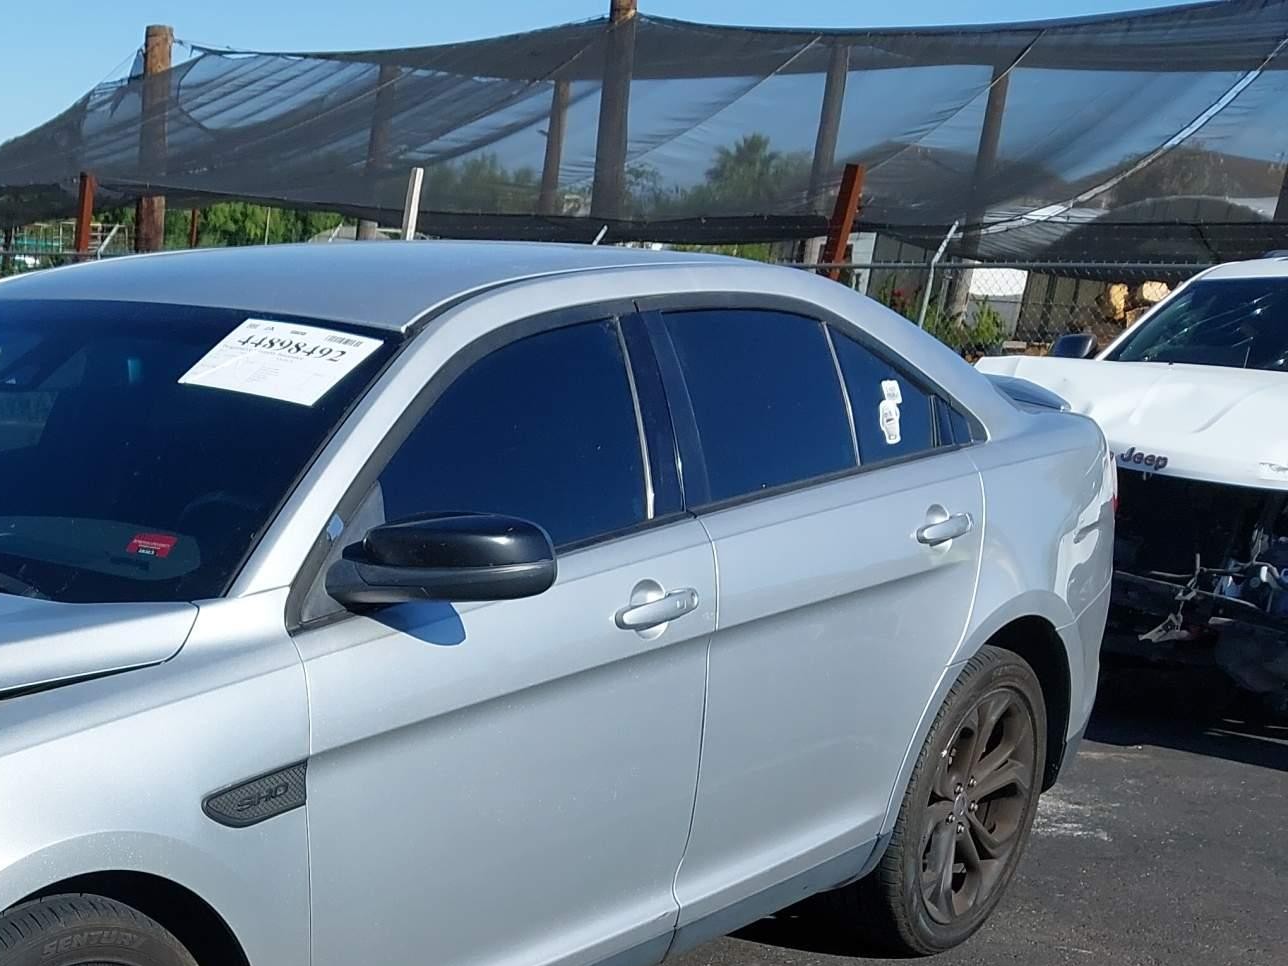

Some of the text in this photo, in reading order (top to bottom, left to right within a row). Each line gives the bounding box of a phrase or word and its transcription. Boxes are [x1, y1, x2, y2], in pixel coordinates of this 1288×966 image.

[237, 335, 347, 362] 44898492
[1120, 446, 1168, 471] Jeep
[235, 782, 289, 812] SHO
[40, 930, 145, 957] SENTURY
